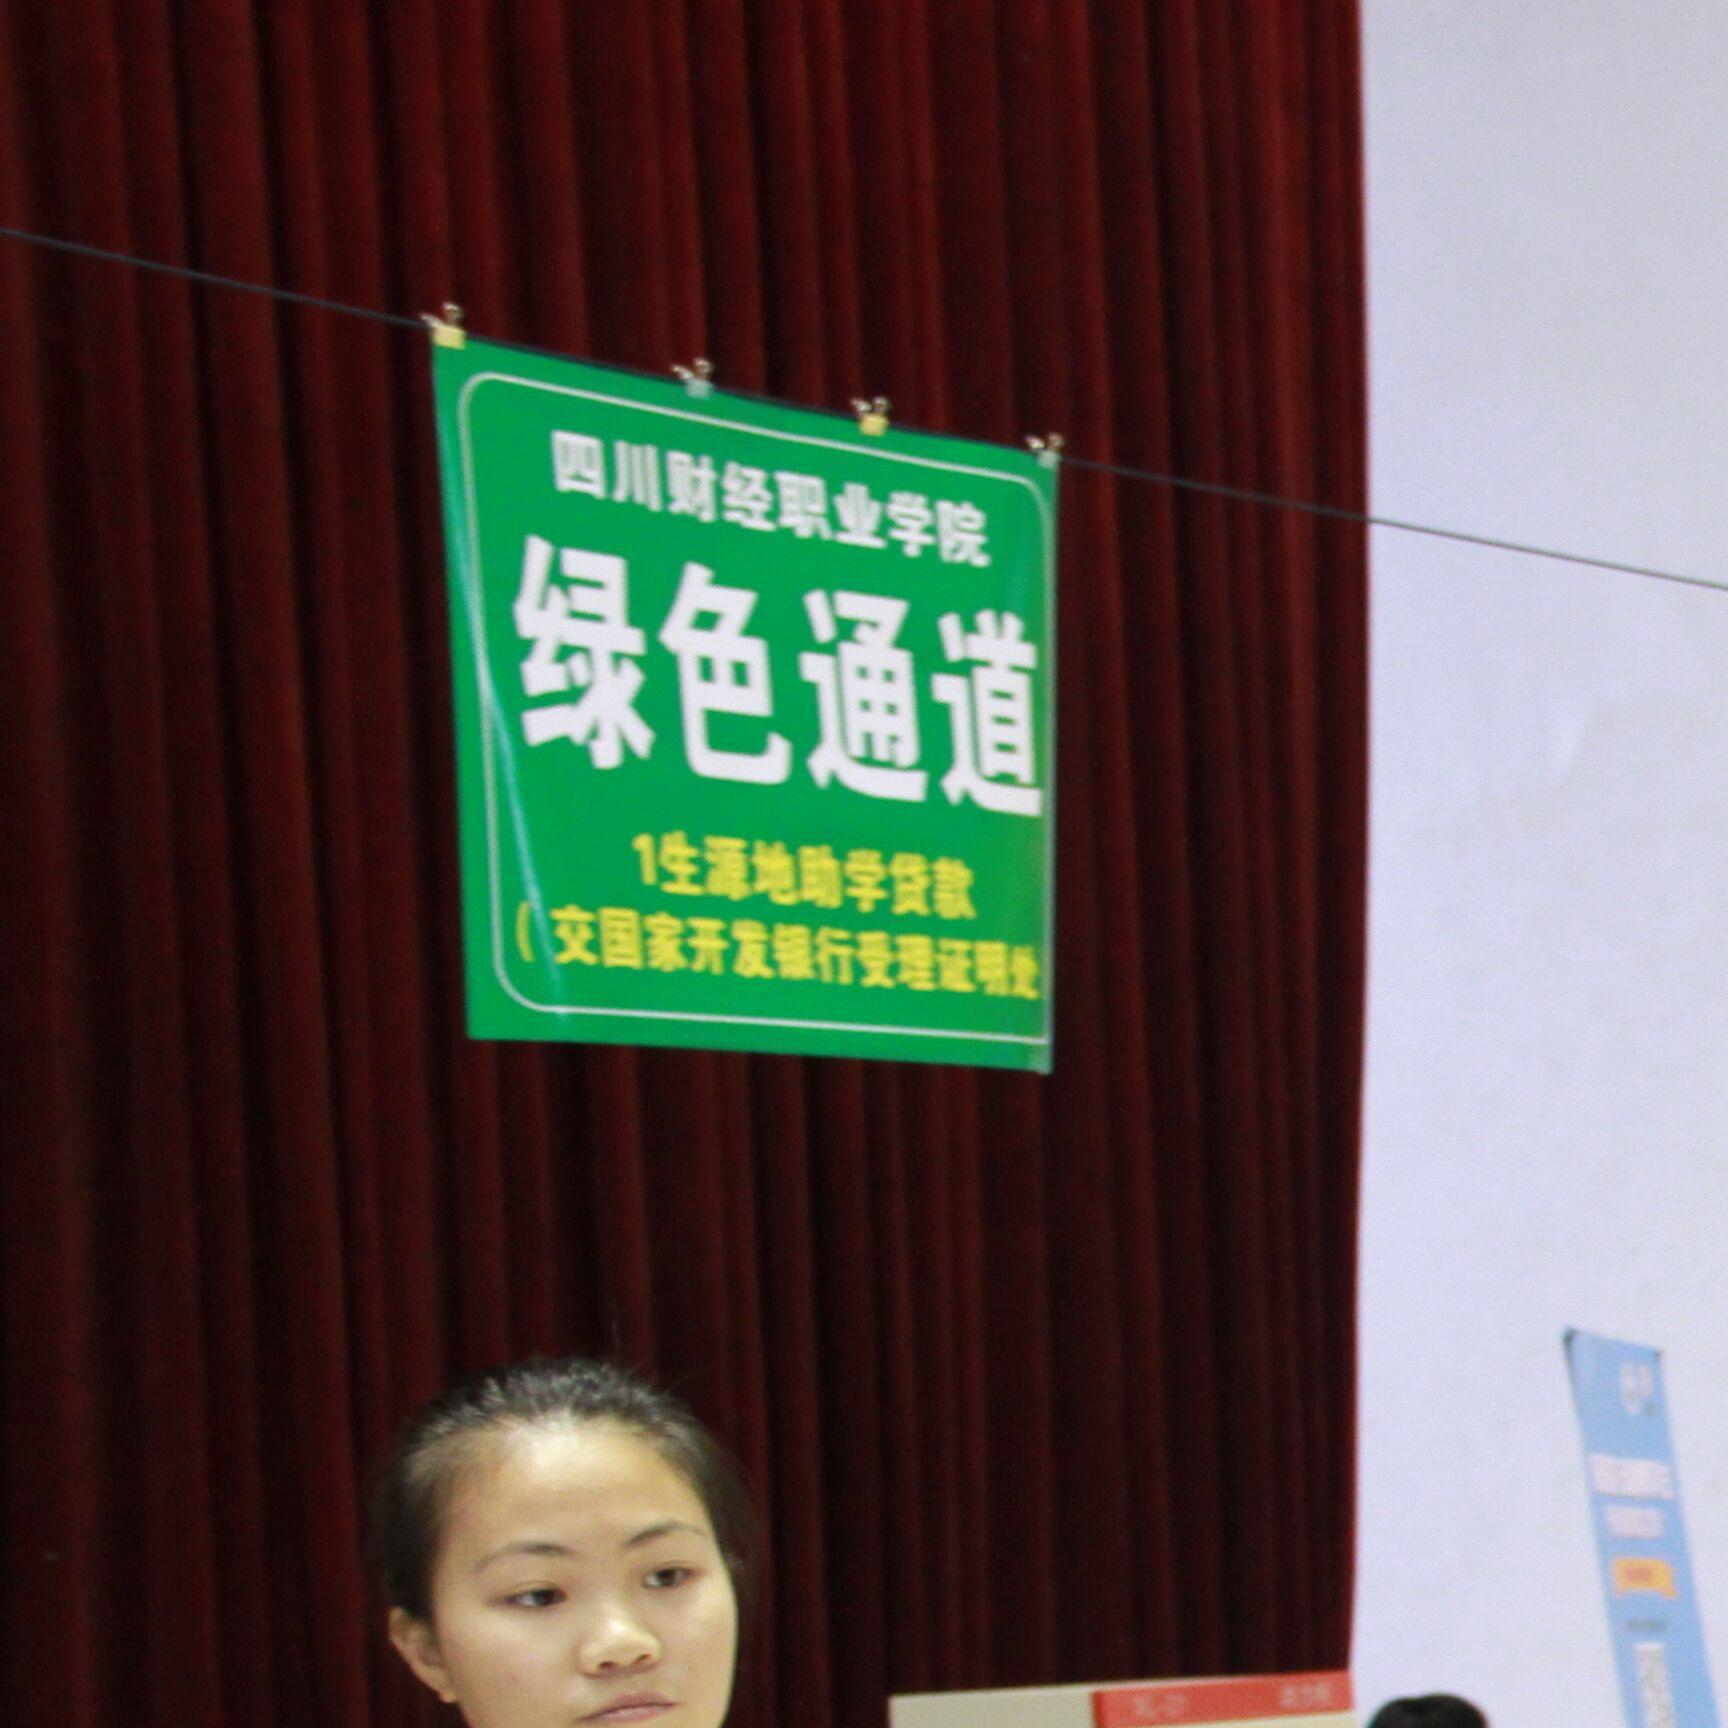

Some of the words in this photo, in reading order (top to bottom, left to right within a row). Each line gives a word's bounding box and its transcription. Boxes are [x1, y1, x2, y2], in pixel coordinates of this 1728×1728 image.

[551, 430, 992, 567] 四川财经职业学院
[513, 534, 1043, 817] 绿色通道
[632, 831, 976, 919] 1生源地助学贷款
